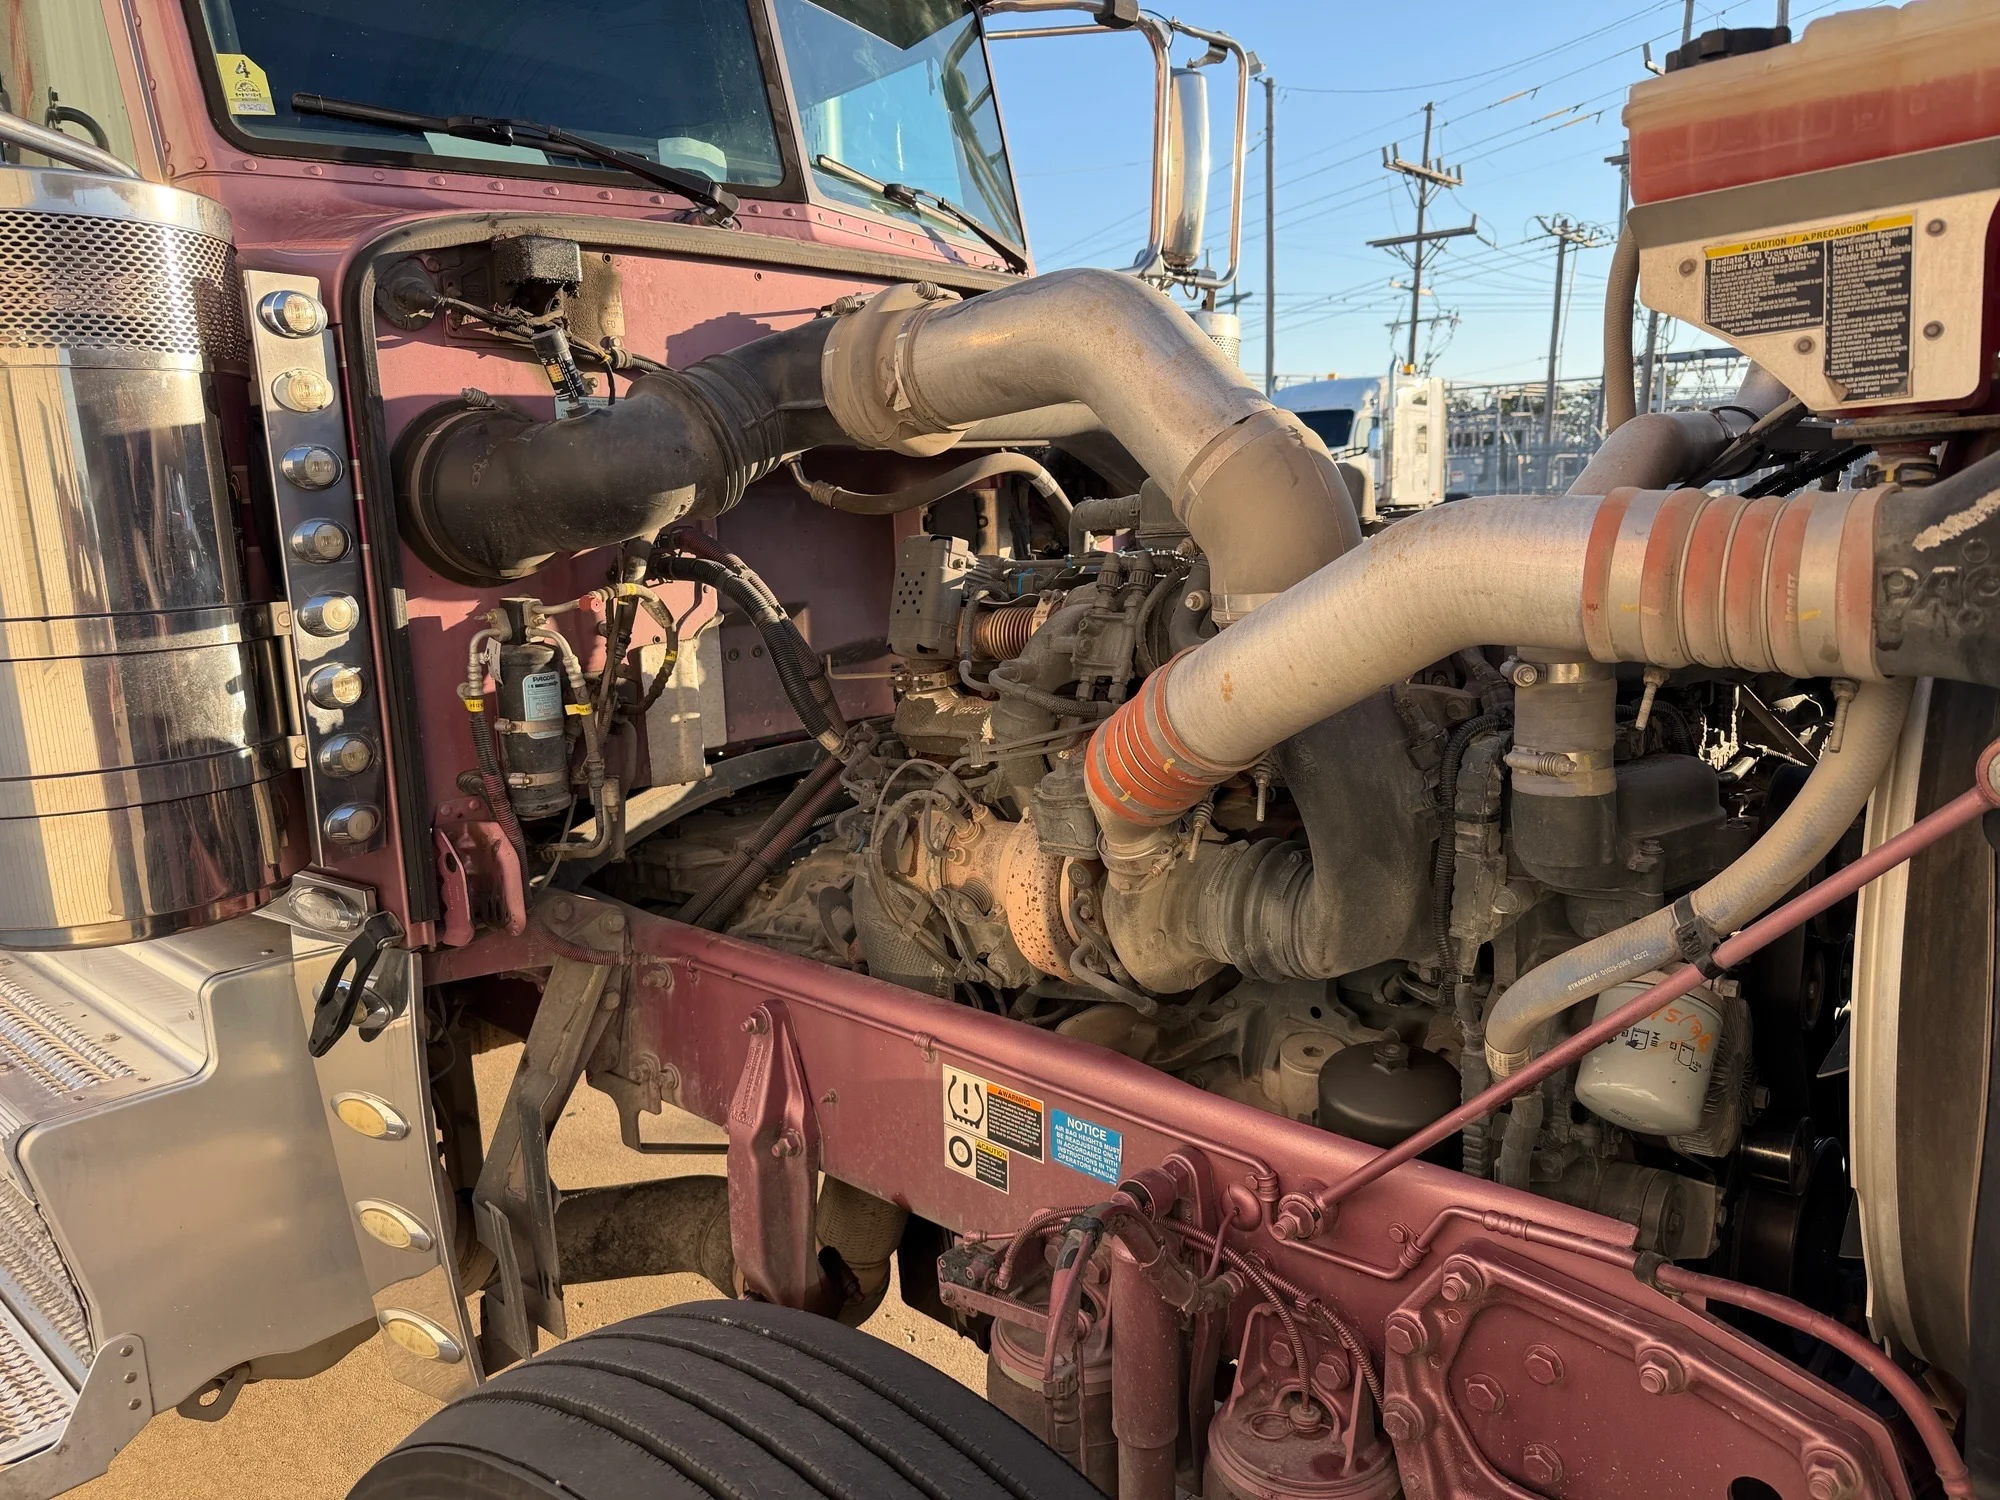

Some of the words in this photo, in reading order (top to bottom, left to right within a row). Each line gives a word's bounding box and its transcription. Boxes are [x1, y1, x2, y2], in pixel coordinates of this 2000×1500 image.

[1711, 256, 1746, 267] Radiator
[1749, 253, 1762, 261] Fill
[1764, 243, 1808, 258] Procedure
[1751, 238, 1786, 250] CAUTION
[1711, 261, 1747, 273] Required
[1750, 259, 1764, 267] For
[1767, 255, 1785, 264] This
[1787, 250, 1820, 261] Vehicle
[1003, 1091, 1030, 1106] WARNING
[1055, 1124, 1064, 1132] AIR
[1065, 1128, 1077, 1138] BAG
[1078, 1134, 1103, 1147] HEIGHTS
[1104, 1144, 1120, 1154] MUST
[1067, 1117, 1106, 1141] NOTICE
[981, 1144, 1006, 1159] CAUTION
[1056, 1131, 1064, 1139] BE
[1065, 1135, 1101, 1154] READJUSTED
[1102, 1150, 1118, 1160] ONLY
[1063, 1142, 1102, 1161] ACCORDANCE
[1103, 1157, 1118, 1168] WITH
[1057, 1146, 1097, 1166] INSTRUCTIONS
[1106, 1165, 1117, 1175] THE
[1058, 1152, 1091, 1171] OPERATORS
[1093, 1167, 1116, 1181] MANUAL
